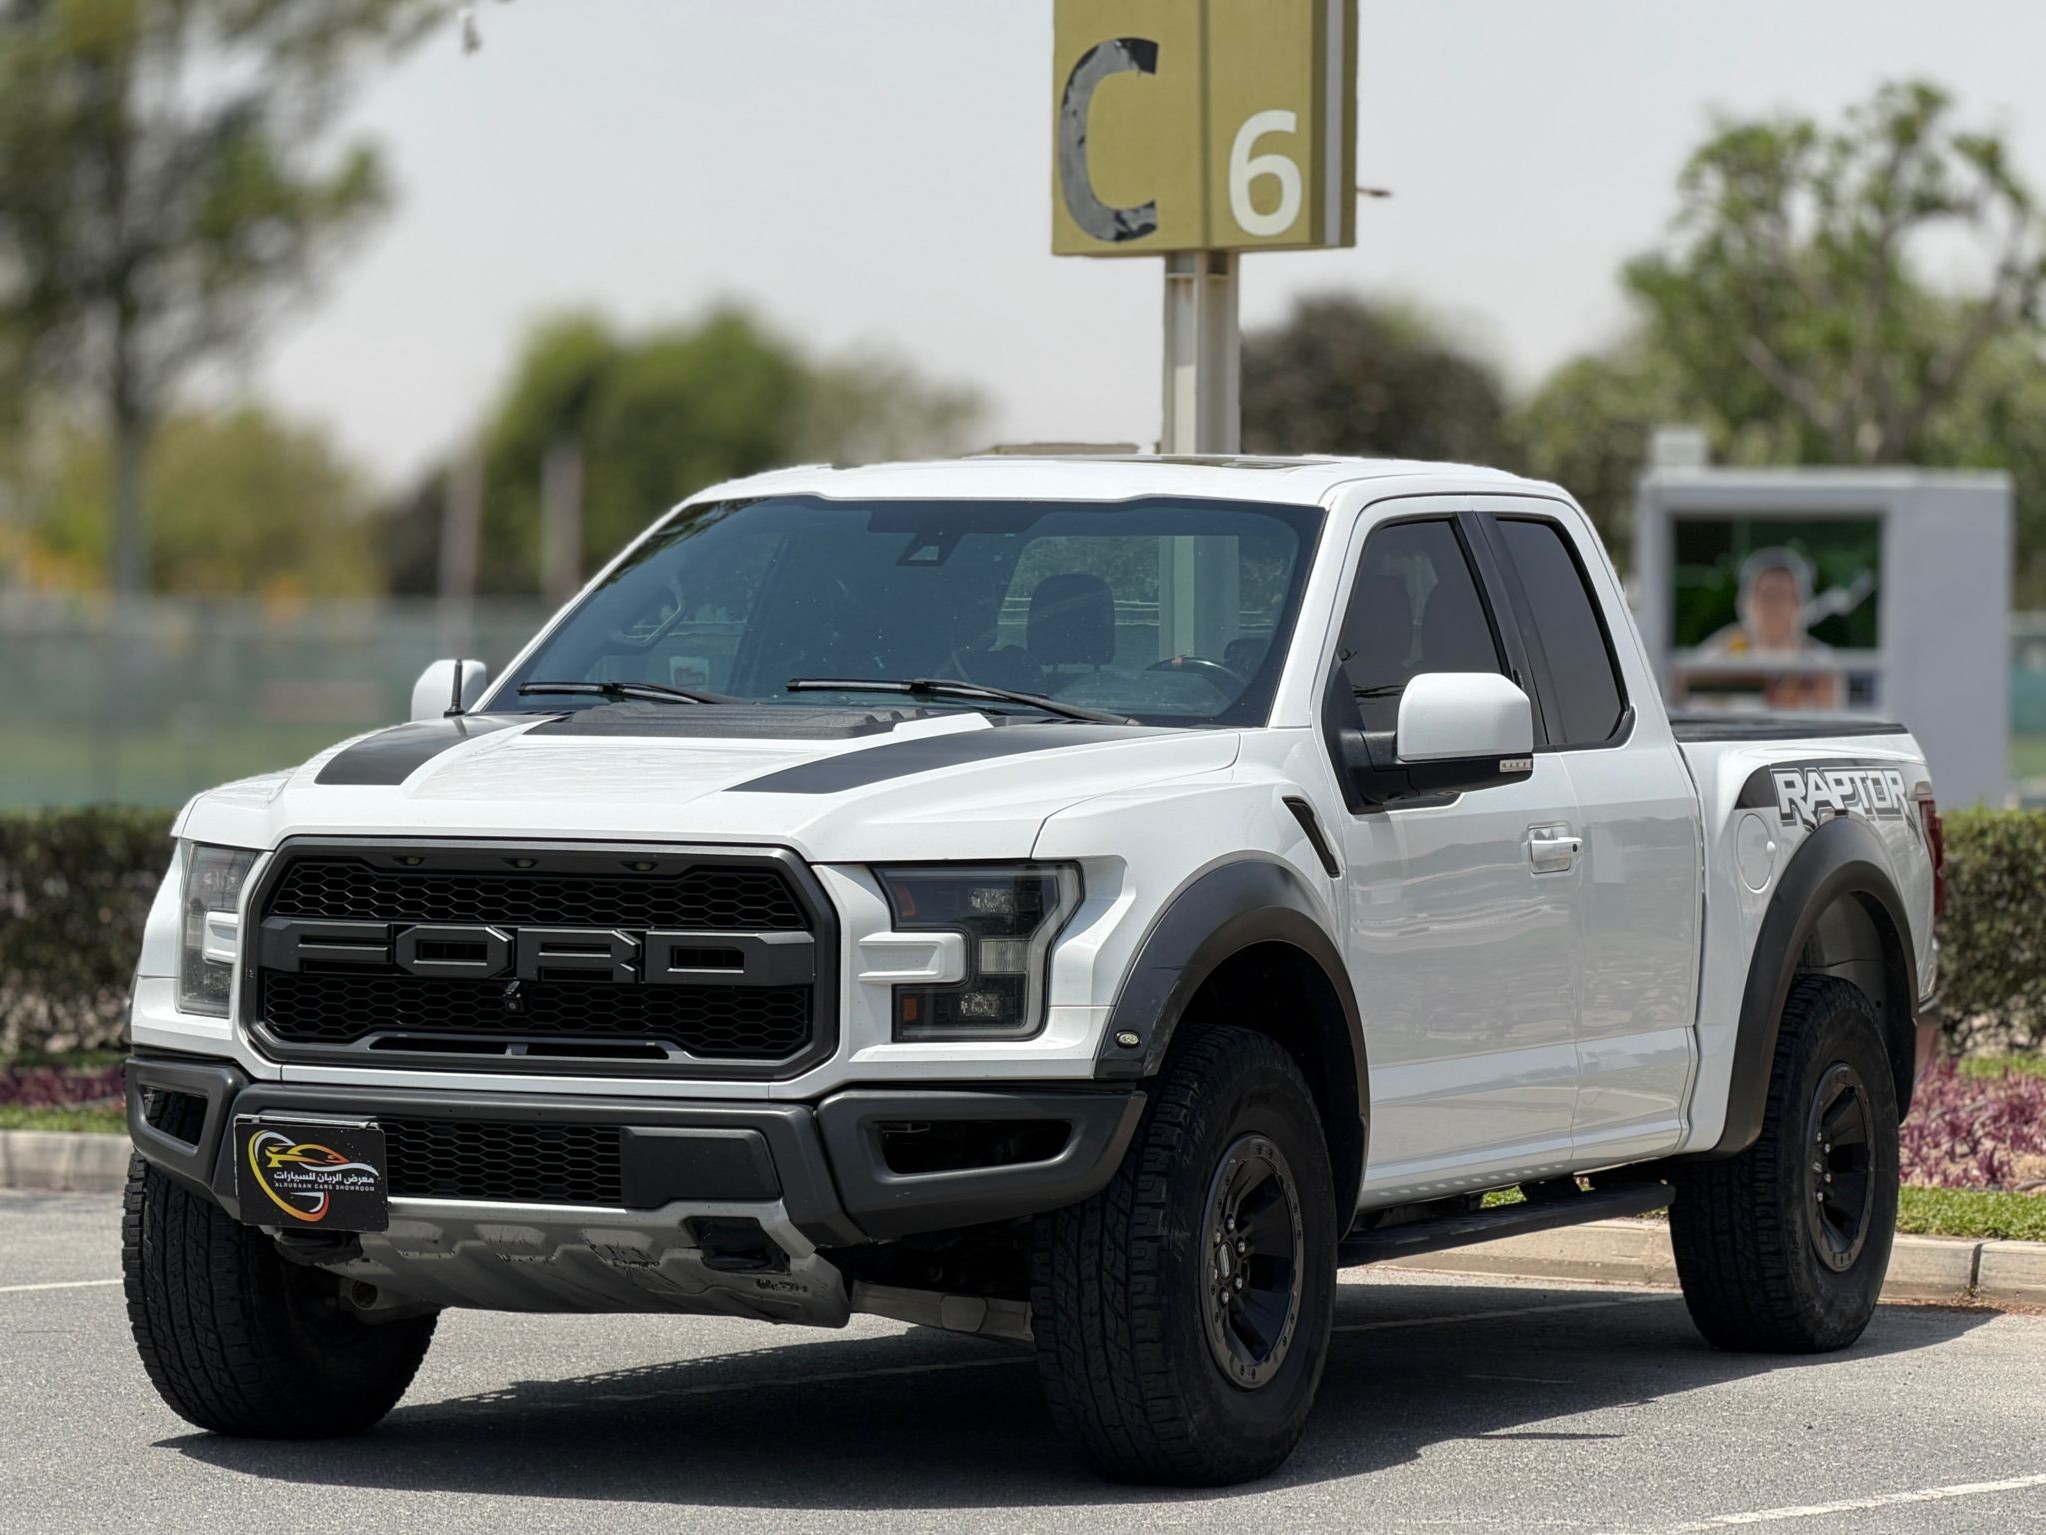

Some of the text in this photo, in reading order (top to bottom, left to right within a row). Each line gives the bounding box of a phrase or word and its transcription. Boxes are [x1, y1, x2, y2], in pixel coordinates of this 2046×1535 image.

[1059, 37, 1158, 243] C
[1229, 109, 1300, 236] 6
[1770, 768, 1910, 830] RAPTOR
[261, 919, 814, 986] FORD
[273, 1170, 375, 1185] معرض الربان للسيارات
[335, 1184, 375, 1192] SHOWROOM
